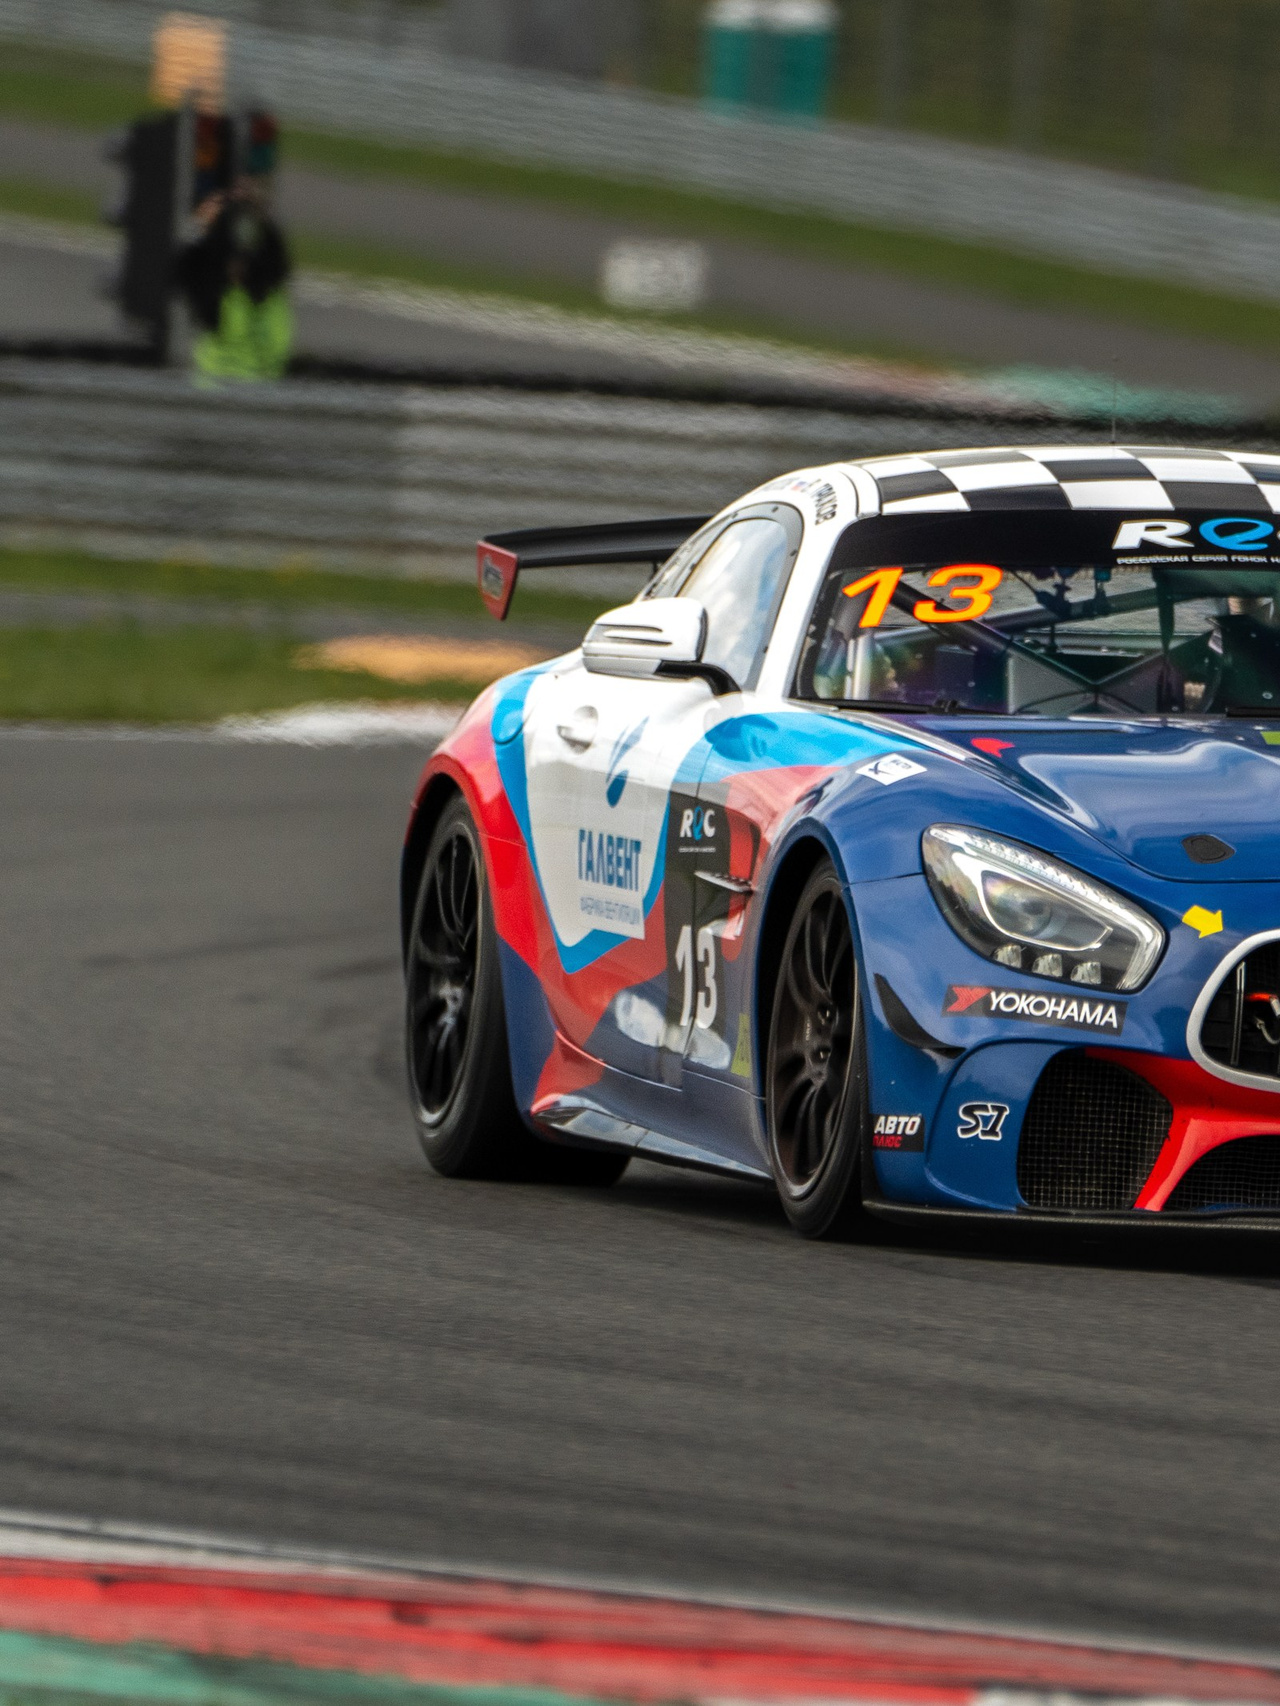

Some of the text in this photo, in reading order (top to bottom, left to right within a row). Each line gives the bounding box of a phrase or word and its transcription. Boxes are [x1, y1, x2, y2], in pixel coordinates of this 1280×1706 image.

[842, 563, 1003, 628] 13
[578, 829, 642, 892] ГАЛВЕНТ
[675, 924, 718, 1029] 13
[989, 990, 1119, 1029] YOKOHAMA
[873, 1115, 922, 1136] АВТО
